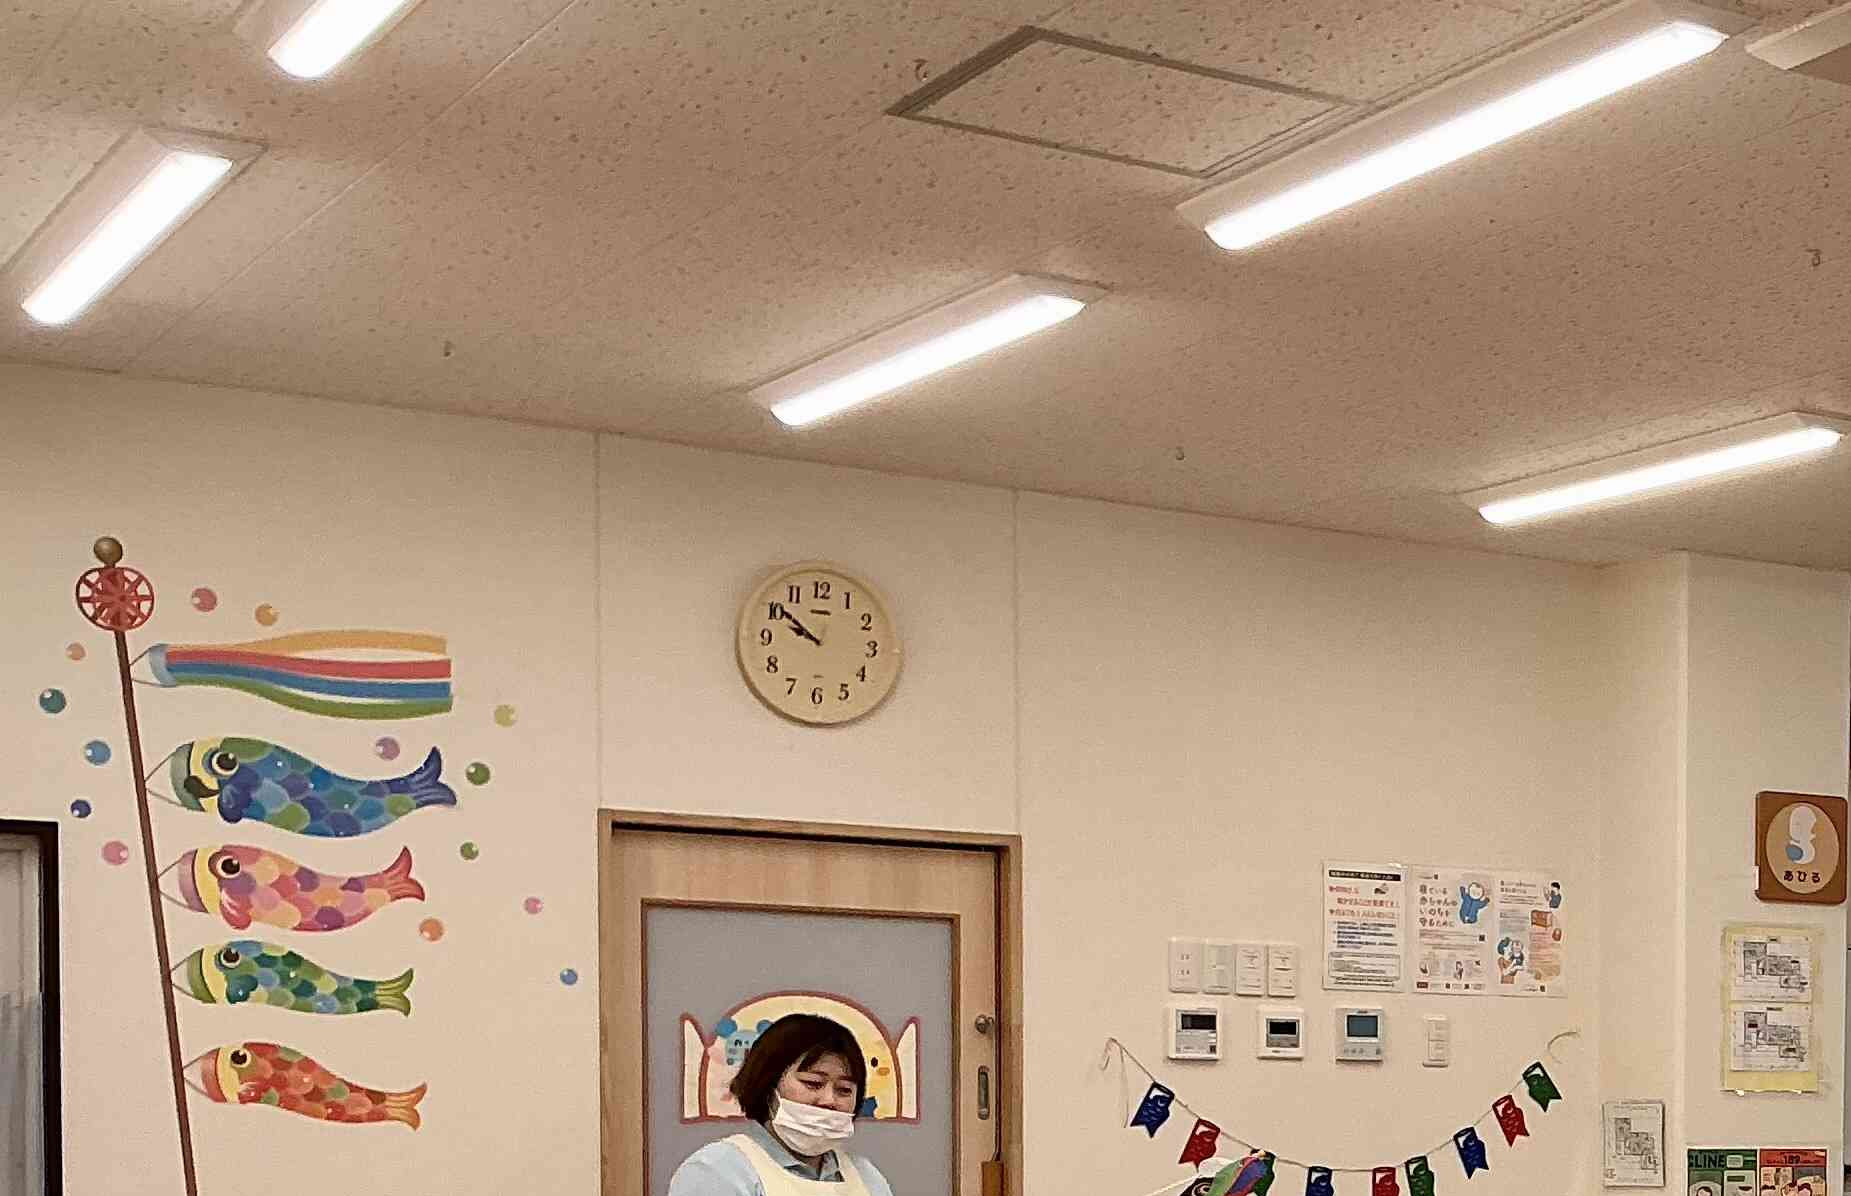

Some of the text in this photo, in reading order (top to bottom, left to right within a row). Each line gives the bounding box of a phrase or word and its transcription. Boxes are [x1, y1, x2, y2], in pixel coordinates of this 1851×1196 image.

[787, 584, 800, 604] 11
[813, 581, 831, 600] 12
[844, 592, 851, 609] 1
[768, 601, 784, 620] 10
[861, 613, 872, 631] 2
[760, 628, 772, 646] 9
[865, 640, 878, 658] 3
[766, 655, 778, 674] 8
[856, 665, 866, 682] 4
[785, 677, 798, 695] 7
[838, 683, 850, 701] 5
[811, 687, 823, 705] 6
[1783, 869, 1821, 884] あひる
